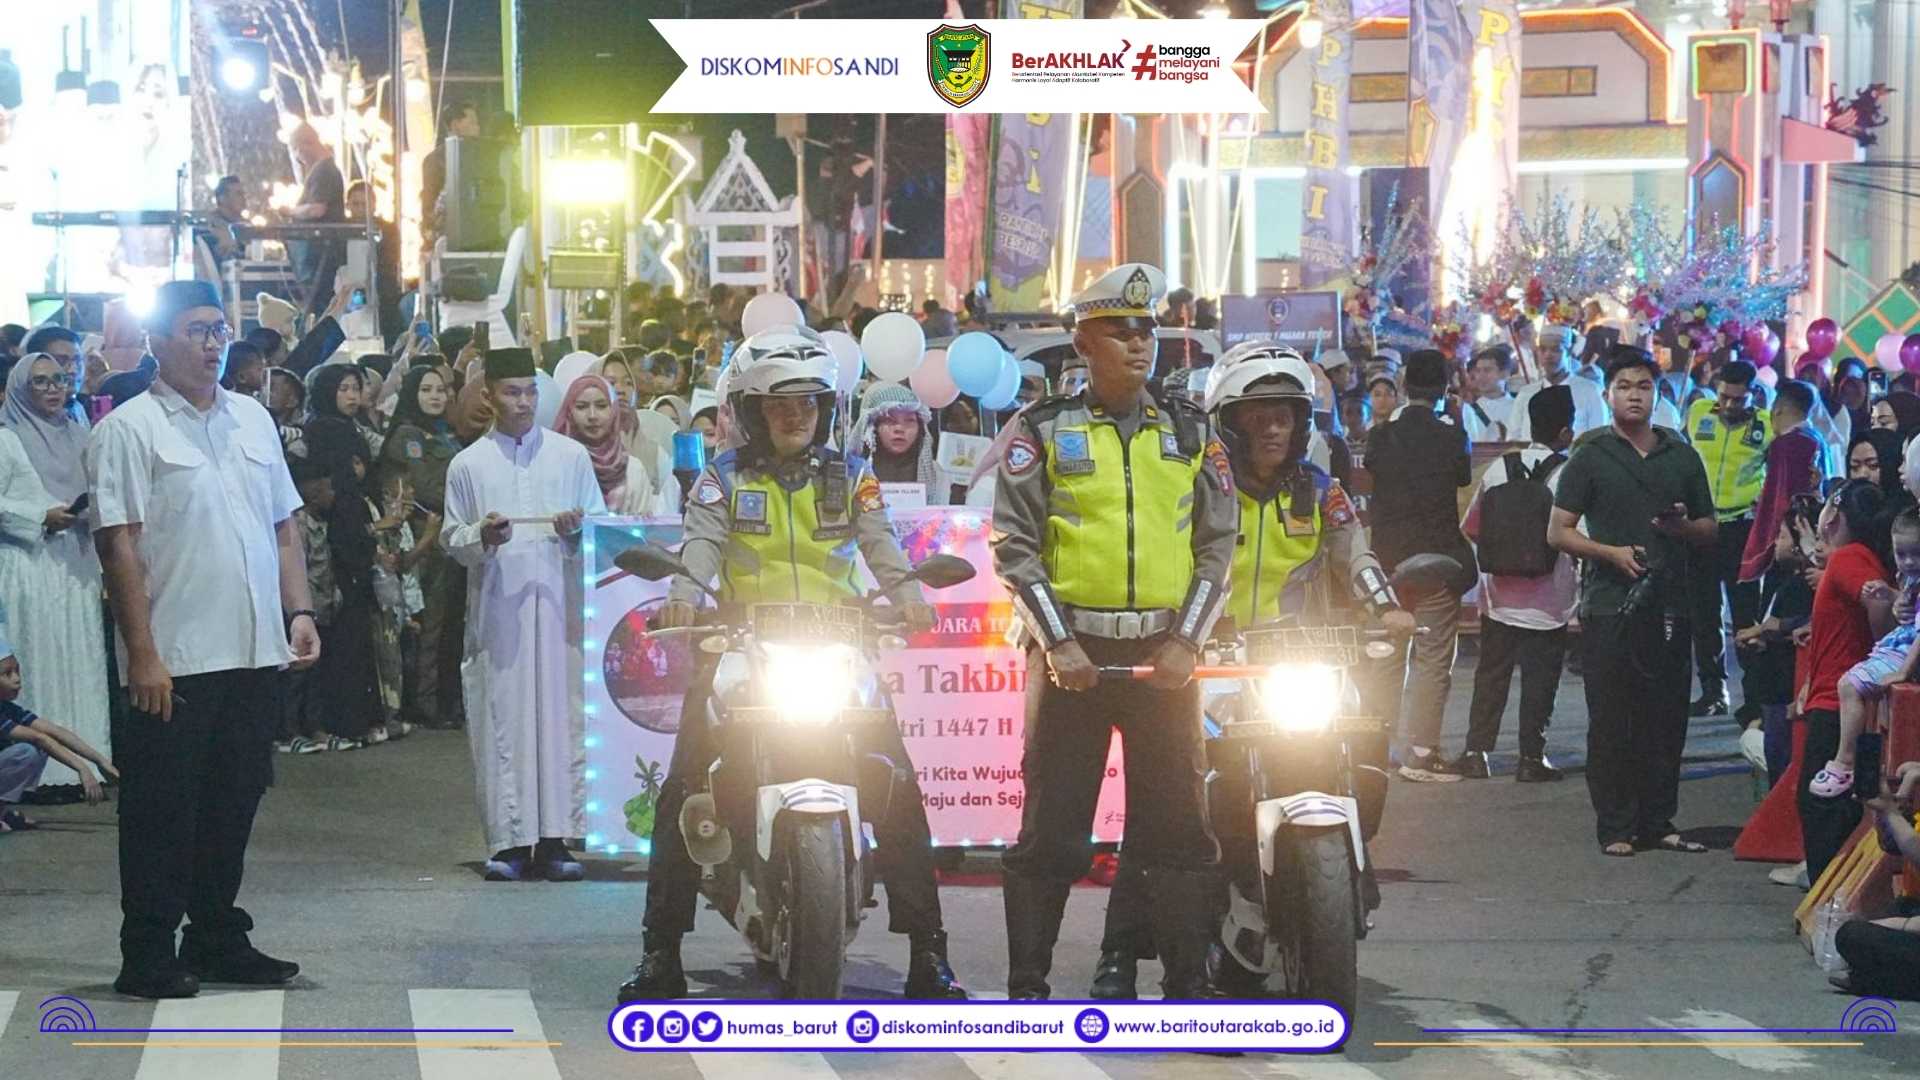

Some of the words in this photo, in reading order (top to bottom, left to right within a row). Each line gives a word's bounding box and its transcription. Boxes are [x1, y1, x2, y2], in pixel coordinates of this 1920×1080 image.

[934, 718, 989, 737] 1447
[997, 718, 1013, 736] H
[932, 766, 968, 781] Kita
[960, 791, 992, 806] dan
